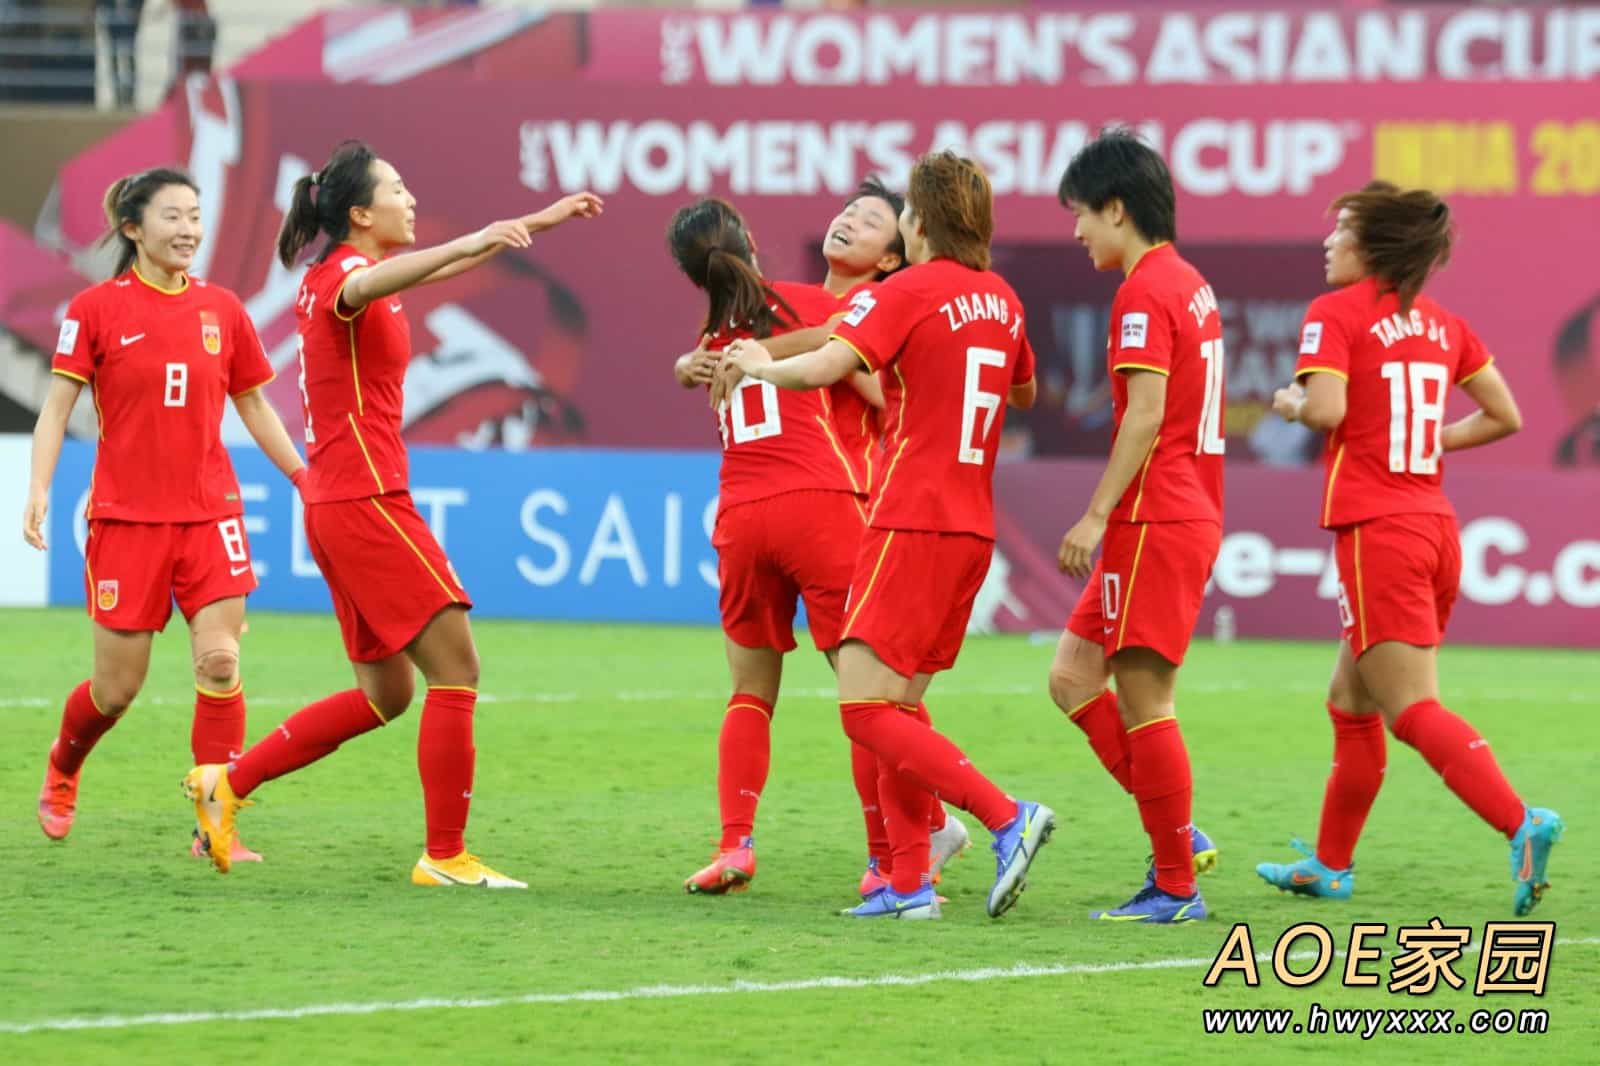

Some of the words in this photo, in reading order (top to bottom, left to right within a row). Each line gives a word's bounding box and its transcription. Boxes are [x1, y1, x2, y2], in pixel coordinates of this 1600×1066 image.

[699, 13, 1138, 84] WOMEN'S
[1146, 12, 1427, 82] ASIAN
[549, 120, 912, 195] WOMEN'S
[1171, 119, 1344, 195] CUP
[939, 292, 1008, 332] ZHANG
[1009, 313, 1022, 340] X
[164, 363, 188, 407] 8
[958, 347, 1006, 465] 6
[1381, 362, 1448, 475] 18
[218, 519, 247, 561] 8
